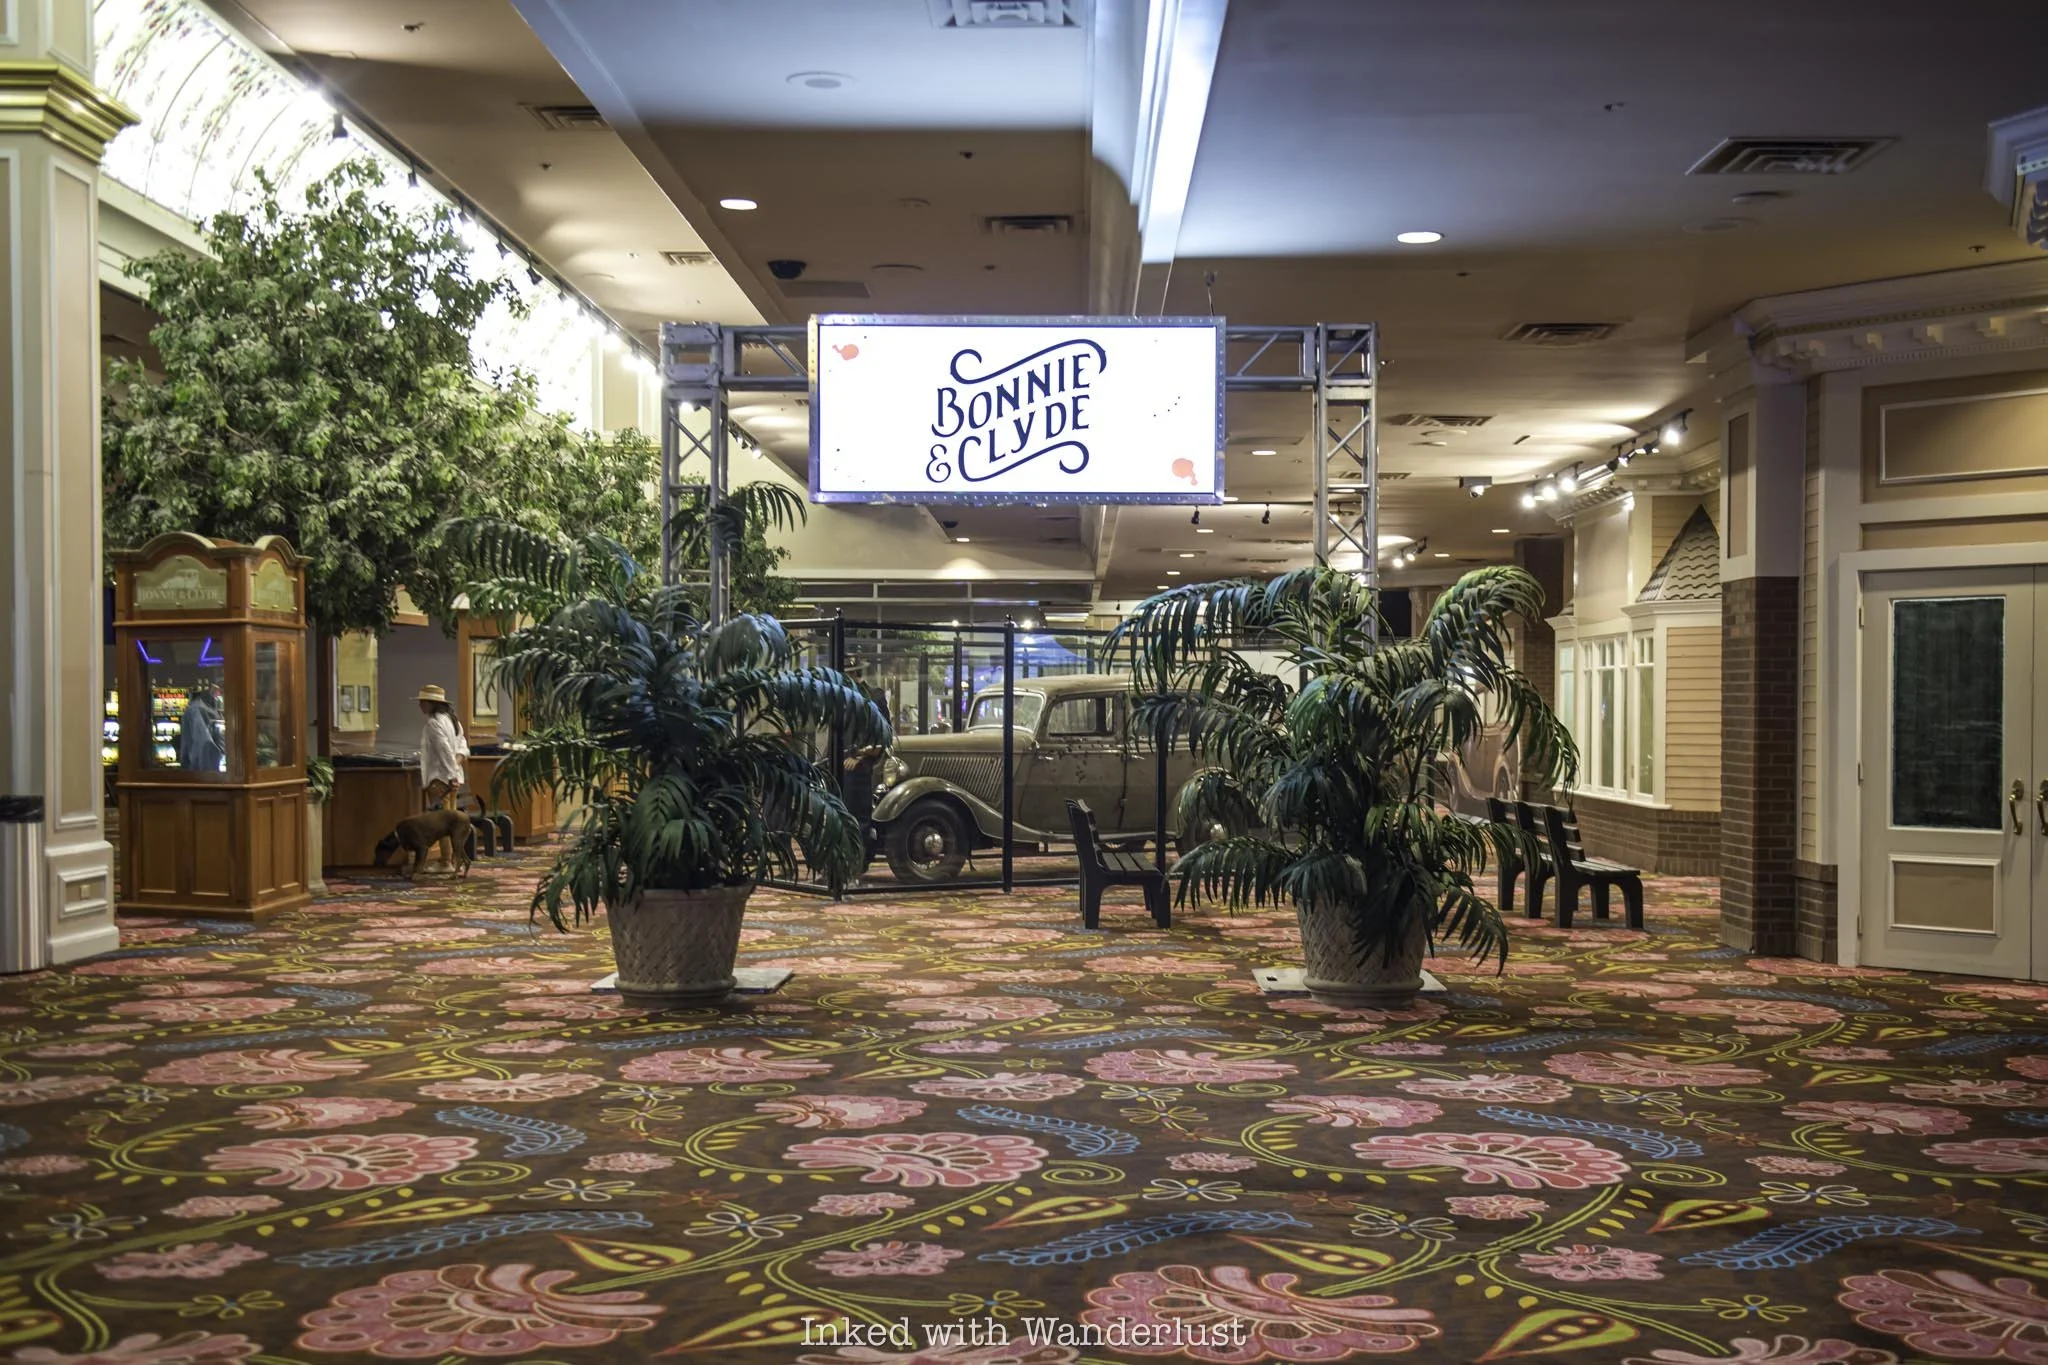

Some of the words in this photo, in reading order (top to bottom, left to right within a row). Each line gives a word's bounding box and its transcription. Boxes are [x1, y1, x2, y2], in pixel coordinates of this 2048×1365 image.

[926, 444, 951, 483] &
[959, 395, 1090, 483] CLYDE
[932, 354, 1091, 438] BONNIE
